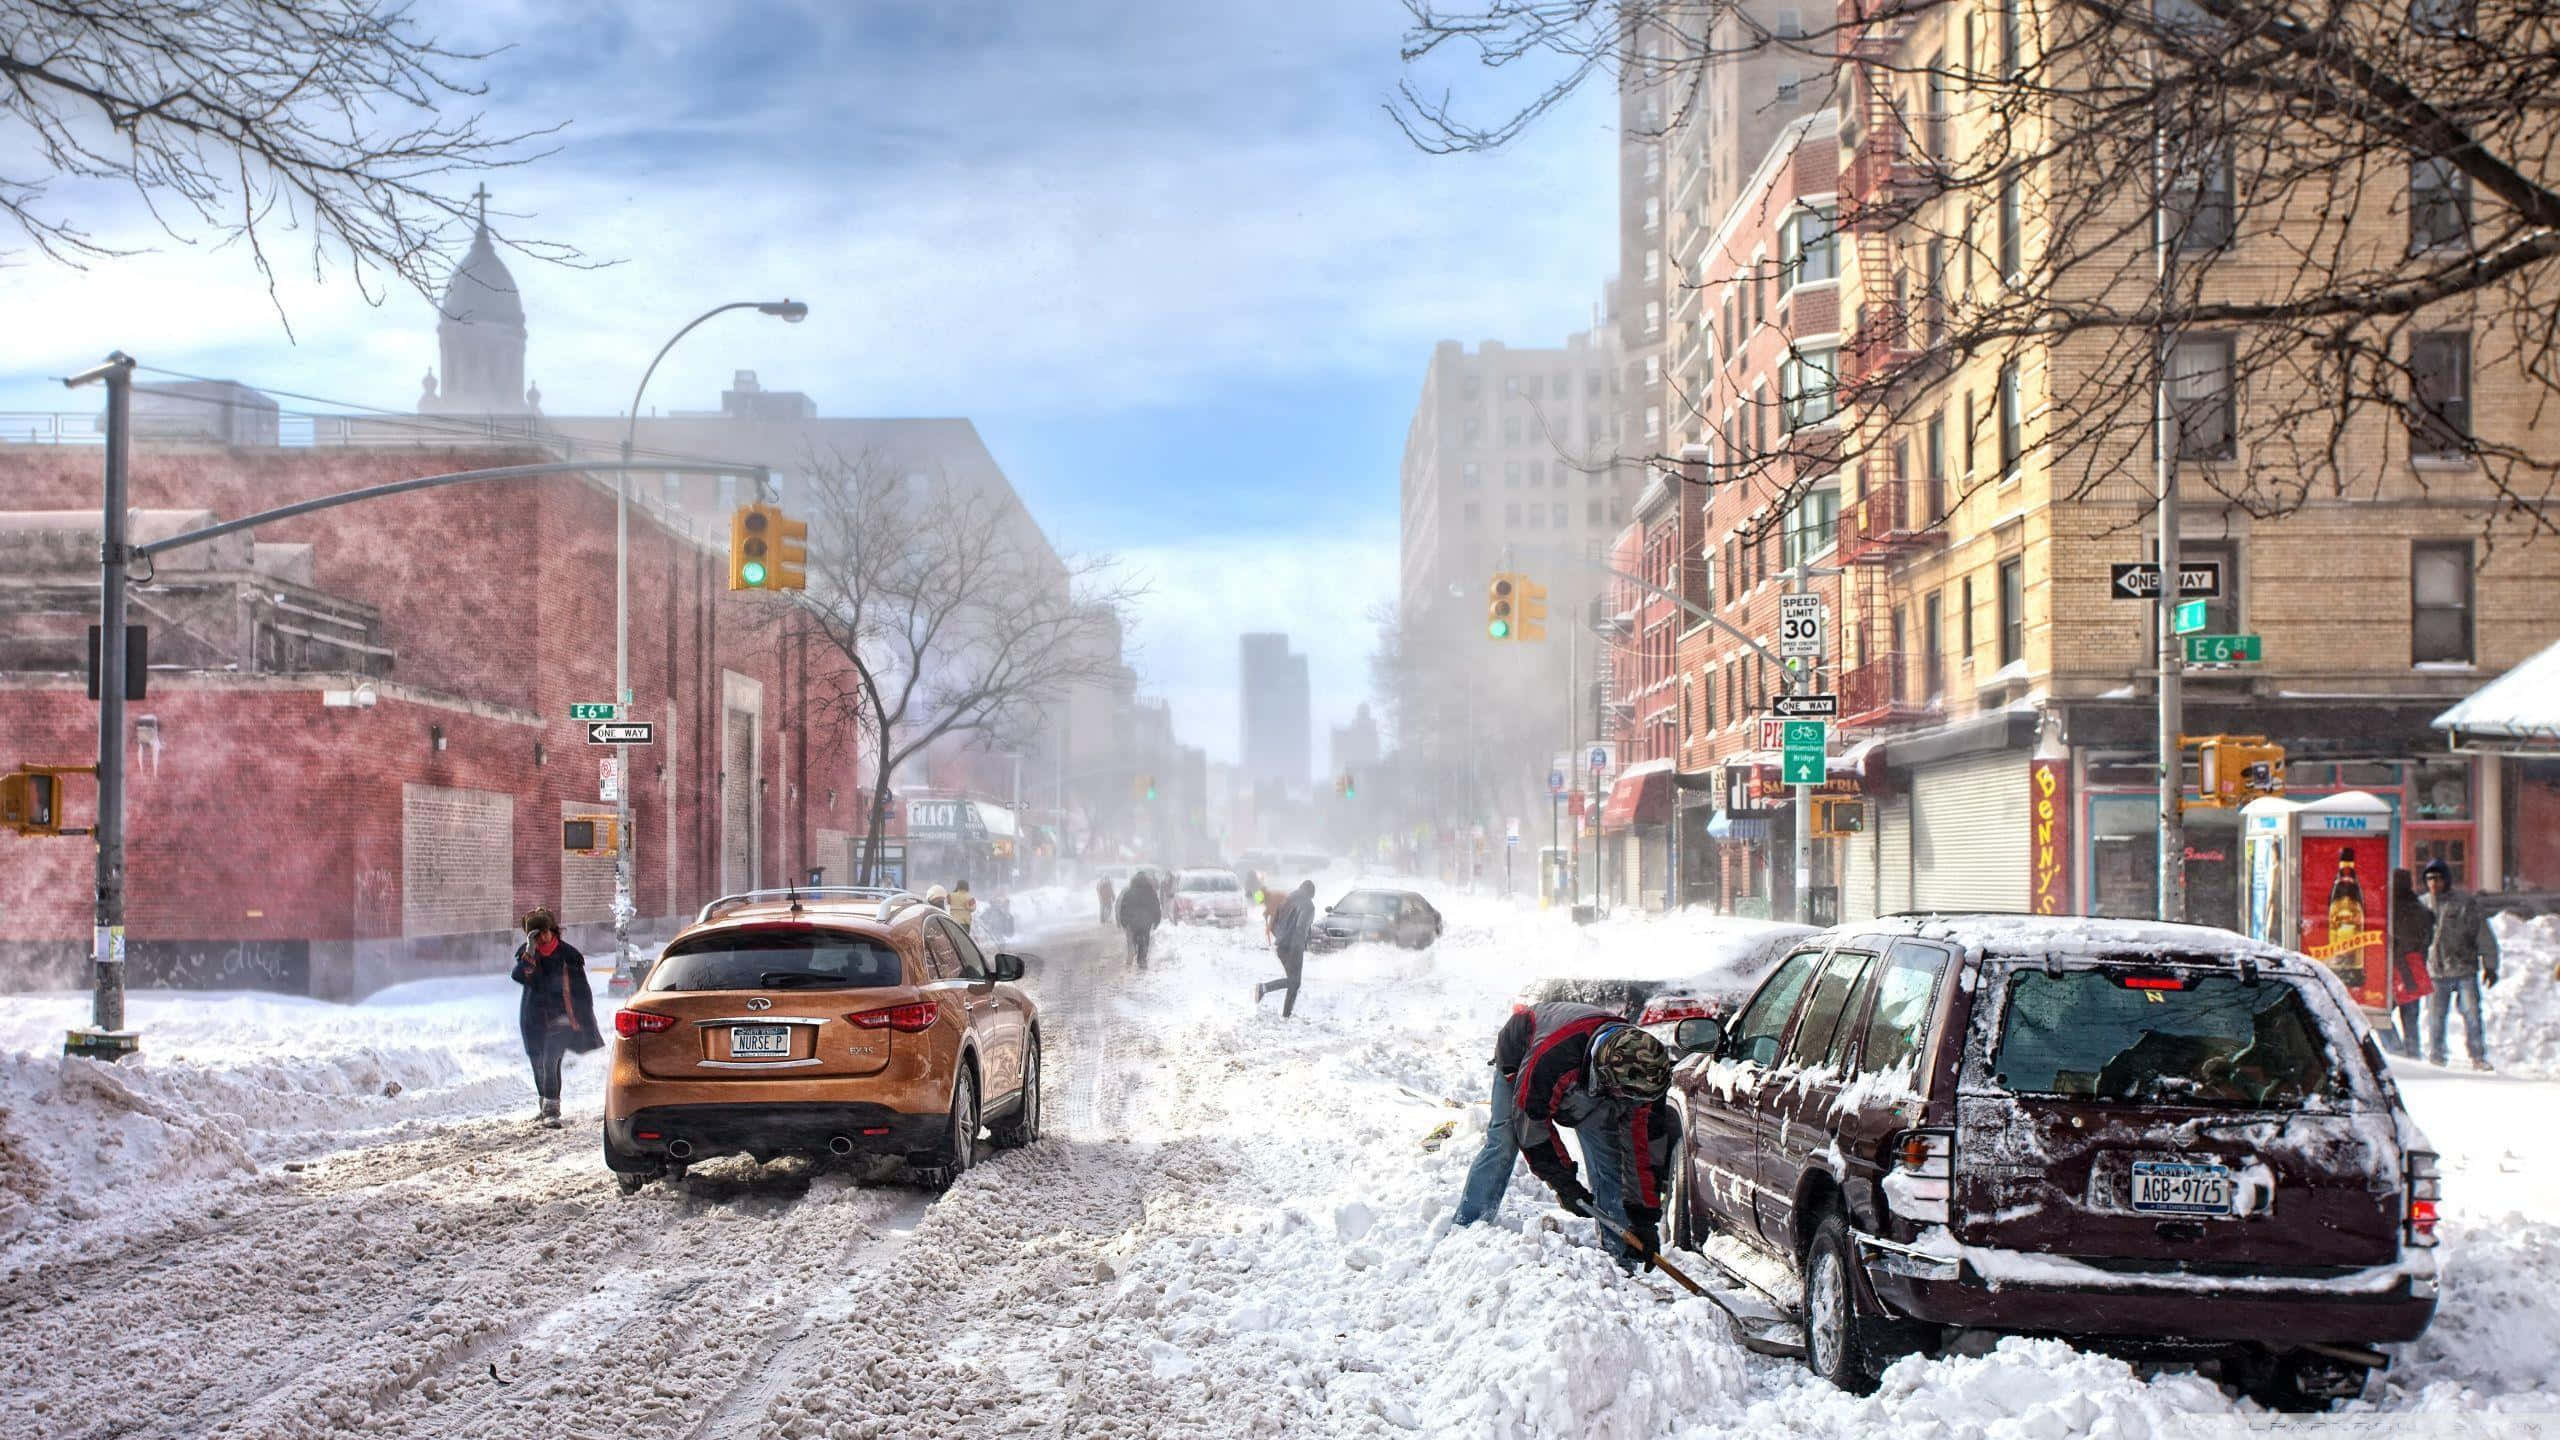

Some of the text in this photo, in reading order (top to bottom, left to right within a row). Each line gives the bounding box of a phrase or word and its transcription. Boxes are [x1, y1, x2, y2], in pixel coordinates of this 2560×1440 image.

[2127, 575, 2159, 588] ONE
[1783, 598, 1818, 607] SPEED
[1786, 609, 1813, 617] LIMIT
[1784, 619, 1816, 639] 30
[2195, 640, 2208, 659] E
[2215, 640, 2228, 659] 6
[577, 706, 585, 718] E
[588, 706, 597, 718] 6
[1782, 702, 1829, 711] ONE WAY
[598, 729, 644, 737] ONE WAY
[1785, 744, 1824, 753] Williamsburg
[1793, 753, 1815, 764] Bridge
[2324, 816, 2367, 829] TITAN
[739, 1036, 782, 1049] NURSE P
